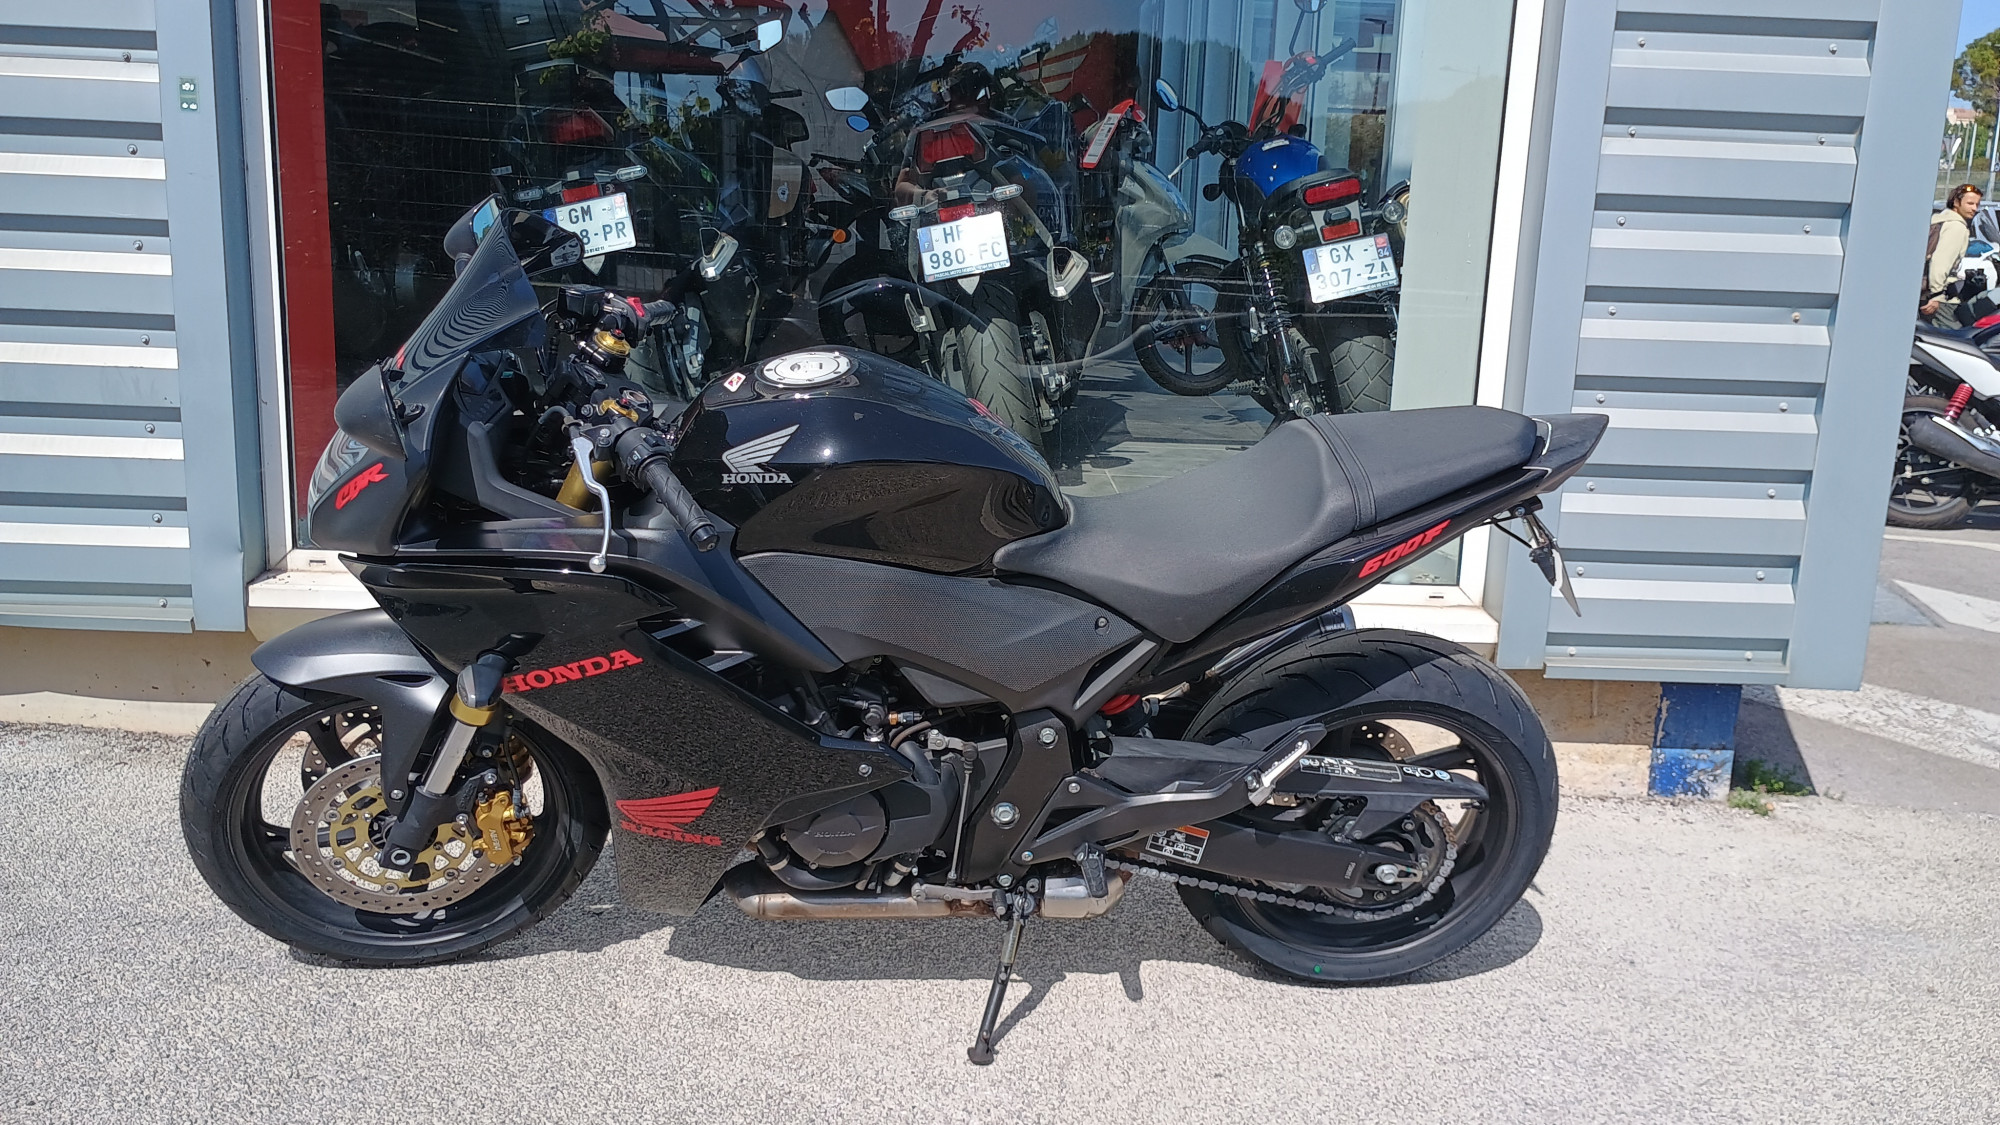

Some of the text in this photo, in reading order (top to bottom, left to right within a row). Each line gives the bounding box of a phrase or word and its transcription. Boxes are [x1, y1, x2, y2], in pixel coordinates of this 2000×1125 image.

[568, 204, 593, 224] GM
[579, 221, 627, 246] 8-PR
[1377, 247, 1390, 258] 34
[721, 473, 793, 484] HONDA
[1358, 519, 1452, 578] 600F
[501, 649, 644, 694] HONDA
